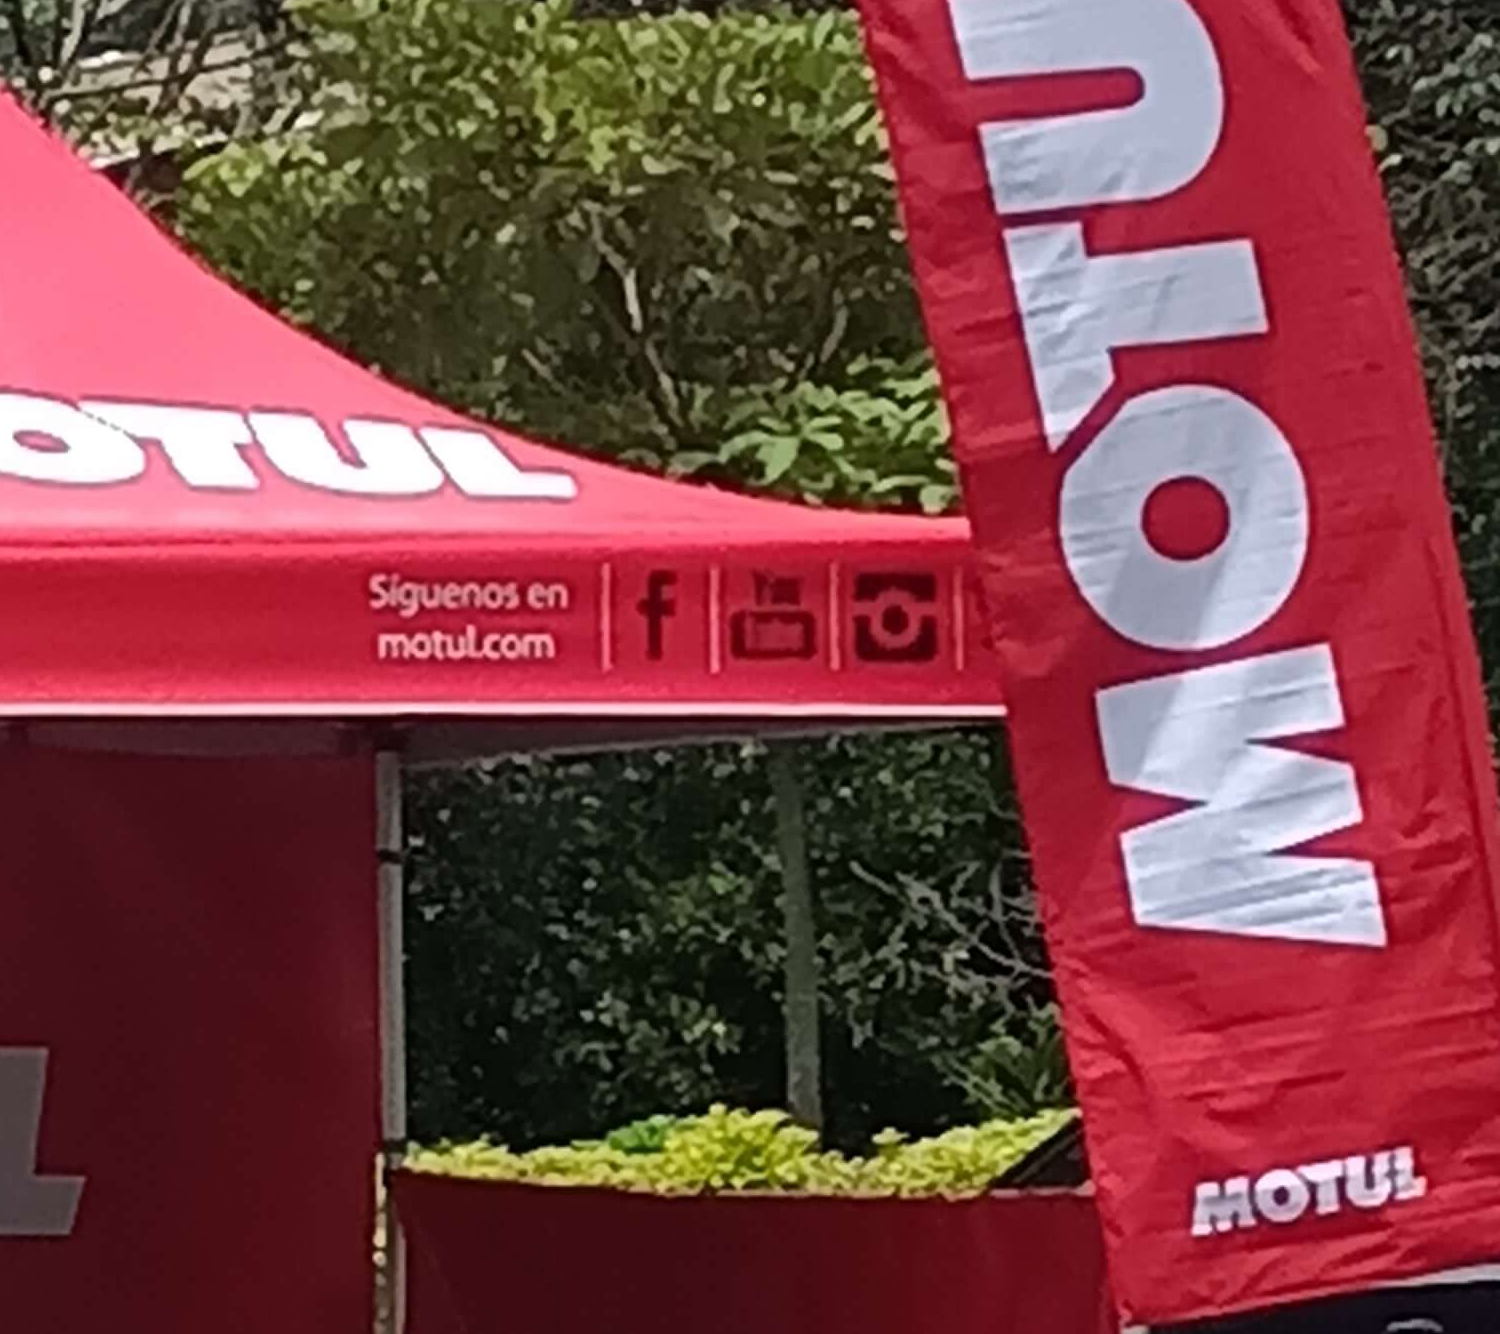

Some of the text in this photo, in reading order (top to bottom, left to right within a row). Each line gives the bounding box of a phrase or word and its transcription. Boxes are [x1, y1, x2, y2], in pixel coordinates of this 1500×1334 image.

[527, 581, 569, 610] en
[377, 624, 556, 659] motul.com
[1191, 1146, 1427, 1236] MOTUL
